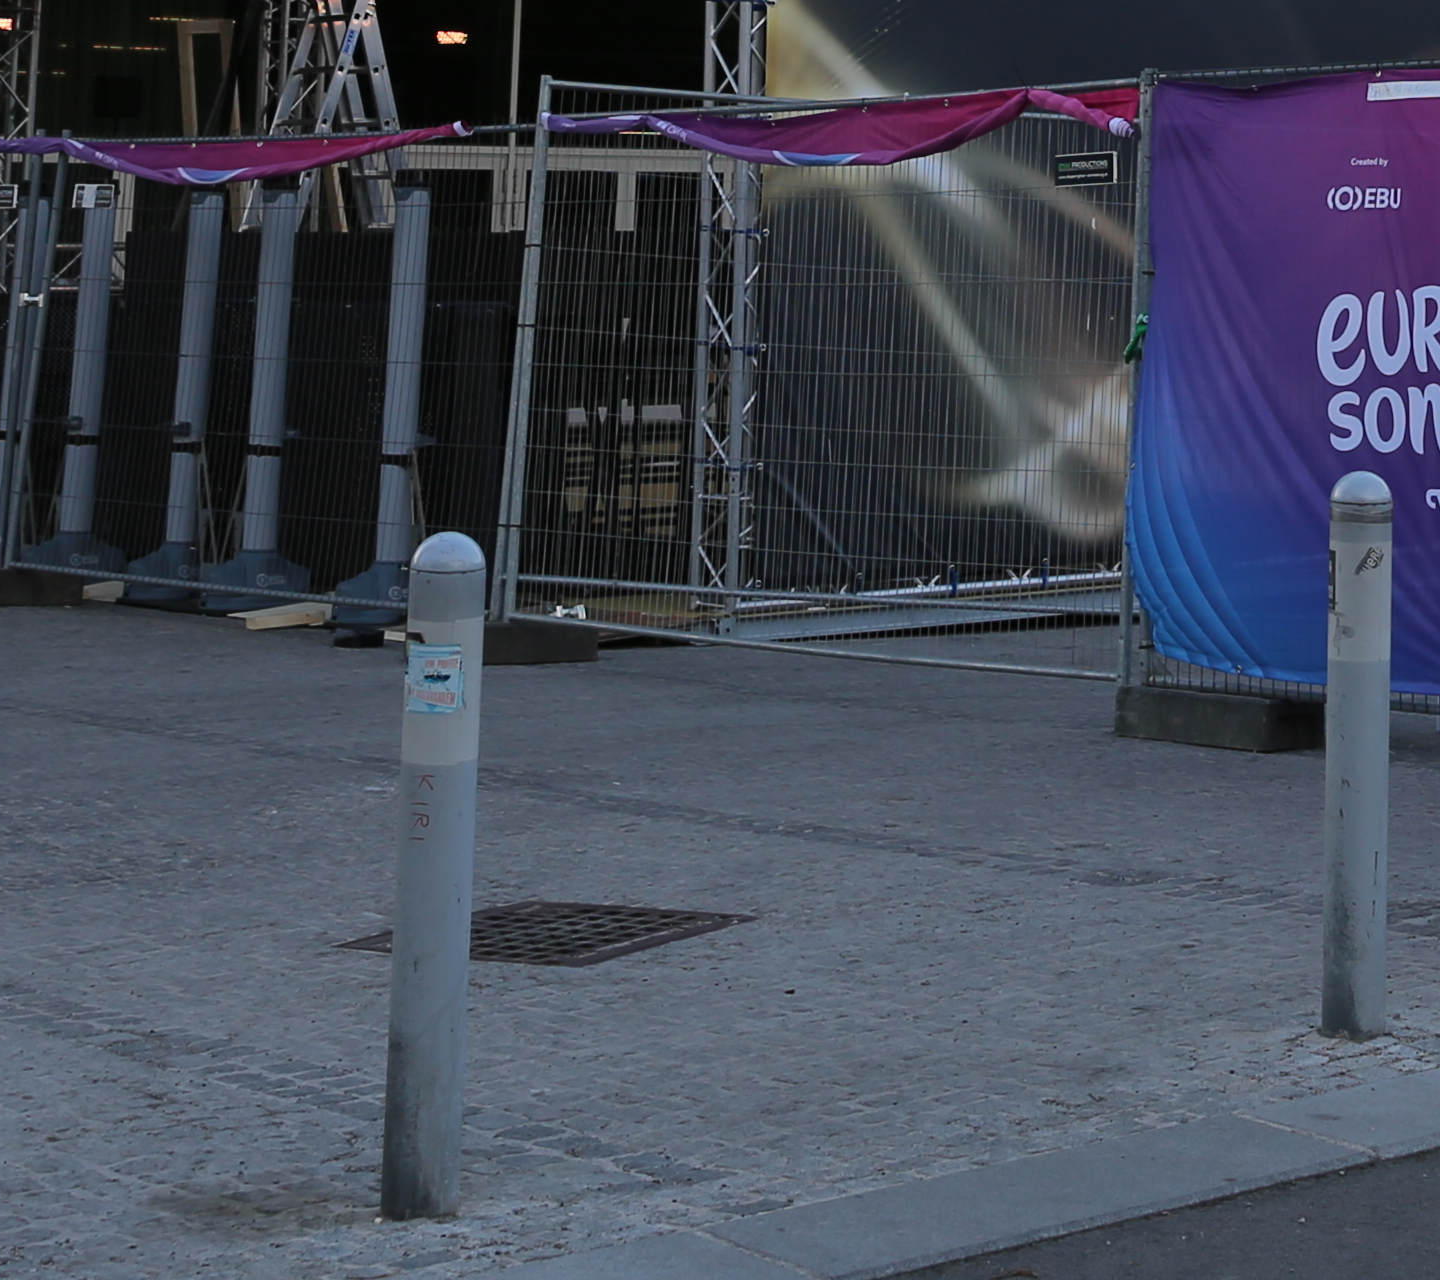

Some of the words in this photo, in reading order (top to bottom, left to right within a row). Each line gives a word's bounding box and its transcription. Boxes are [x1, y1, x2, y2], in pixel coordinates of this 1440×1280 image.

[1350, 156, 1378, 166] Created
[1379, 157, 1389, 168] by
[1363, 187, 1403, 210] EBU
